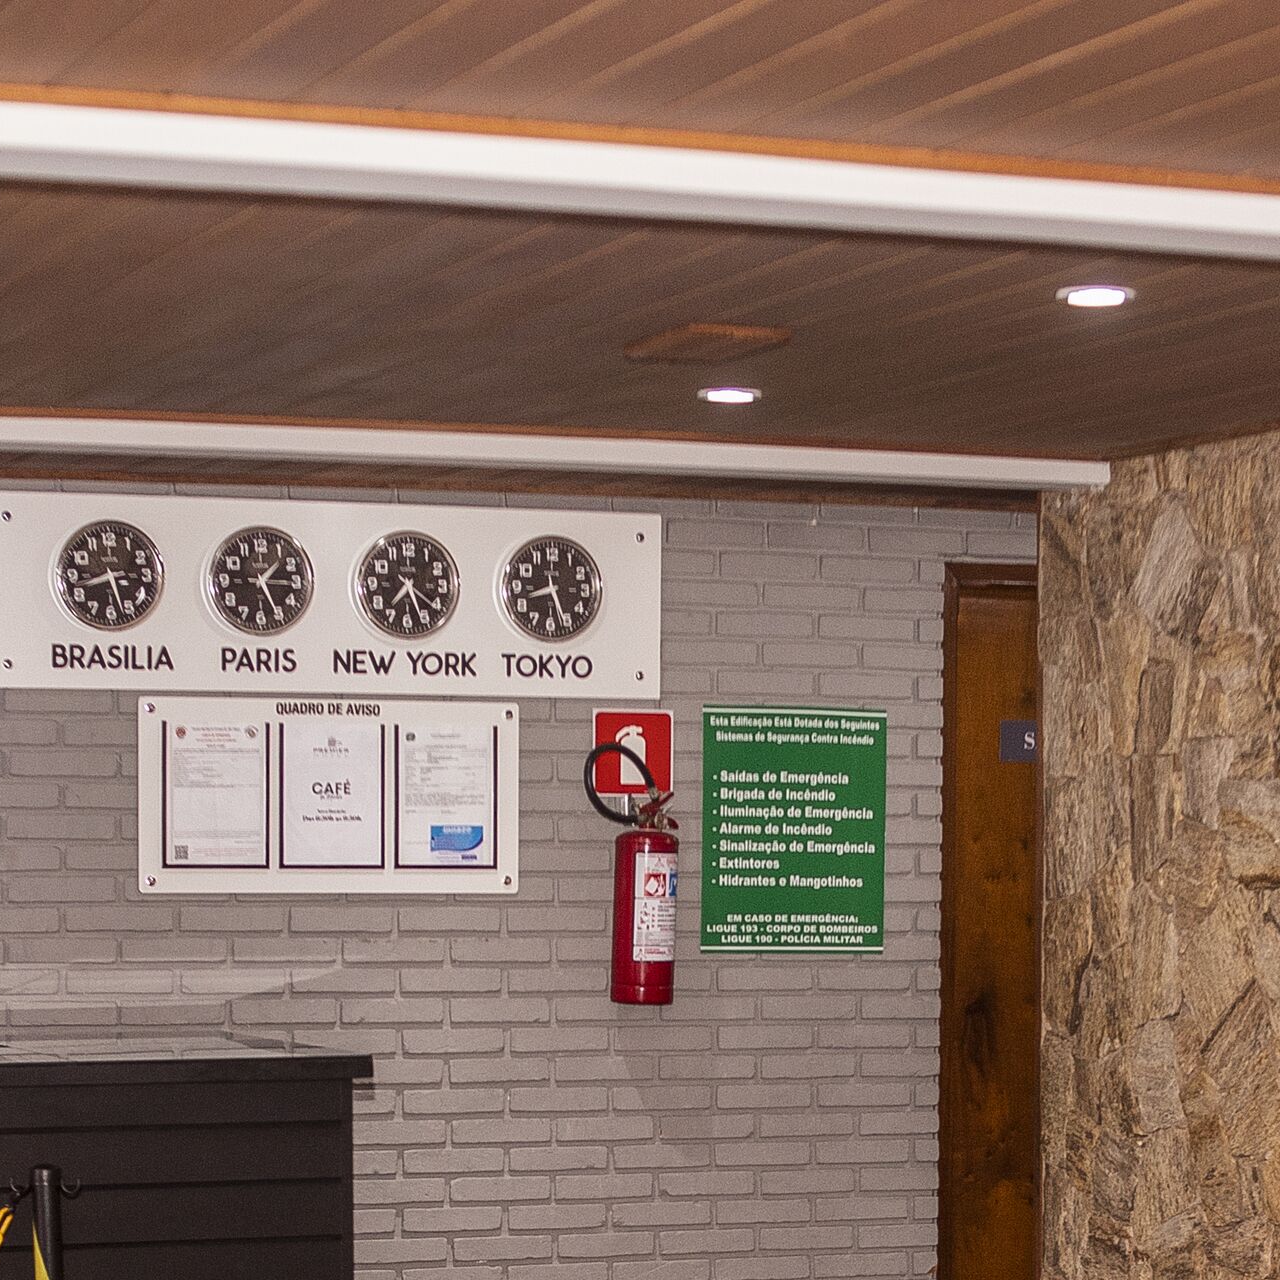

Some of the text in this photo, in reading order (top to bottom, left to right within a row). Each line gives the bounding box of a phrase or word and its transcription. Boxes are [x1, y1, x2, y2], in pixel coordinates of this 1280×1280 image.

[73, 550, 89, 565] 10
[225, 556, 240, 571] 10
[374, 560, 388, 574] 10
[519, 563, 532, 577] 10
[285, 593, 296, 607] 4
[432, 597, 441, 611] 4
[87, 601, 99, 616] 7
[238, 606, 249, 620] 7
[574, 601, 584, 615] 4
[386, 609, 396, 623] 7
[529, 612, 539, 626] 7
[51, 643, 175, 671] BRASILIA
[220, 646, 297, 673] PARIS
[332, 649, 477, 677] NEW YORK
[501, 653, 593, 679] TOKYO
[276, 701, 381, 717] QUADRO DE AVISO
[710, 715, 880, 732] Esta Edificação Está Dotada dos Seguintes
[716, 731, 874, 745] Sistemas de Segurança Contra Incêndio
[720, 770, 849, 786] Saídas de Emergência
[312, 778, 351, 795] CAFÉ
[720, 788, 836, 802] Brigada de Incêndio
[720, 805, 874, 821] Iluminação de Emergência
[719, 823, 832, 835] Alarme de Incêndio
[719, 840, 875, 855] Sinalização de Emergência
[719, 857, 780, 869] Extintores
[719, 874, 863, 889] Hidrantes e Mangotinhos
[727, 914, 742, 922] EM
[744, 914, 772, 922] CASO
[775, 914, 788, 922] DE
[706, 924, 737, 933] LIGUE
[766, 925, 801, 933] CORPO
[803, 925, 817, 933] DE
[819, 925, 878, 933] BOMBEIROS
[721, 935, 752, 943] LIGUE
[780, 934, 821, 943] POLÍCIA
[823, 935, 863, 944] MILITAR
